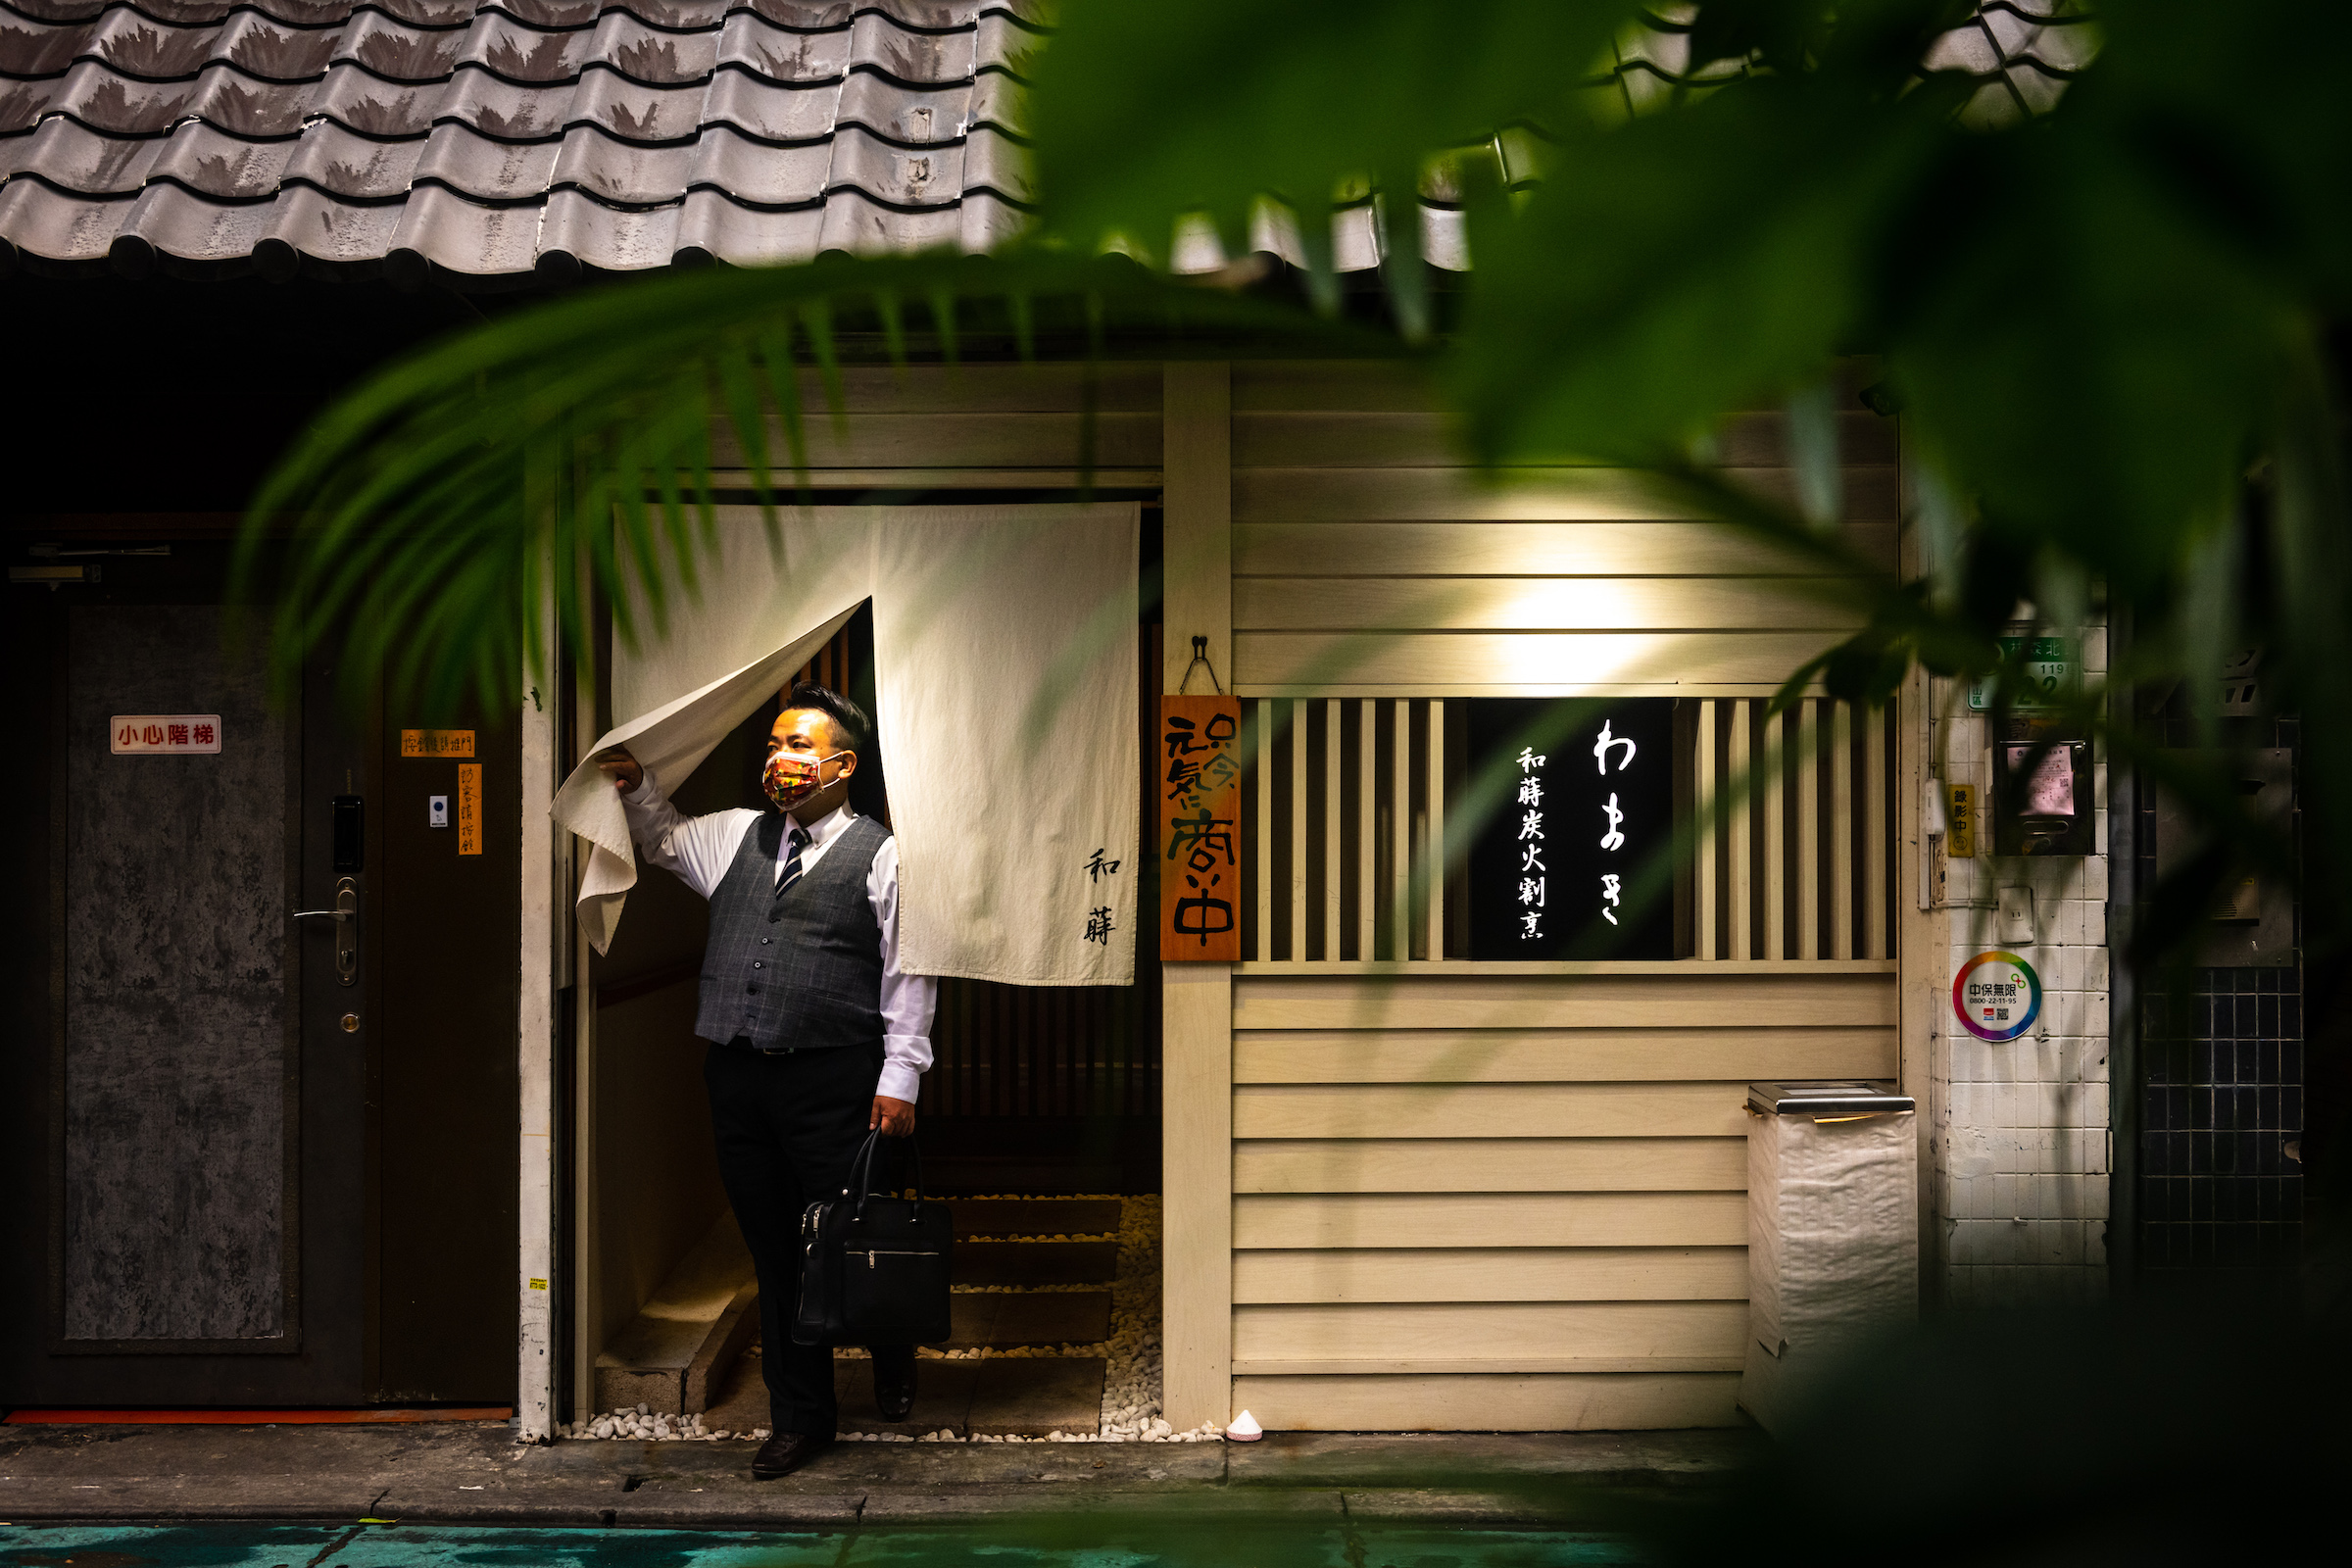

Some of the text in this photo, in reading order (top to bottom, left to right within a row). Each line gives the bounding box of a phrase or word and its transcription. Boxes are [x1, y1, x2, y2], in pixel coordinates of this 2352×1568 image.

[2009, 639, 2070, 657] 林森北
[118, 723, 215, 746] 小心階梯
[1954, 790, 1967, 832] 錄影中
[1515, 746, 1547, 940] 和蒔炭火割烹
[1969, 983, 2017, 997] 中保無限
